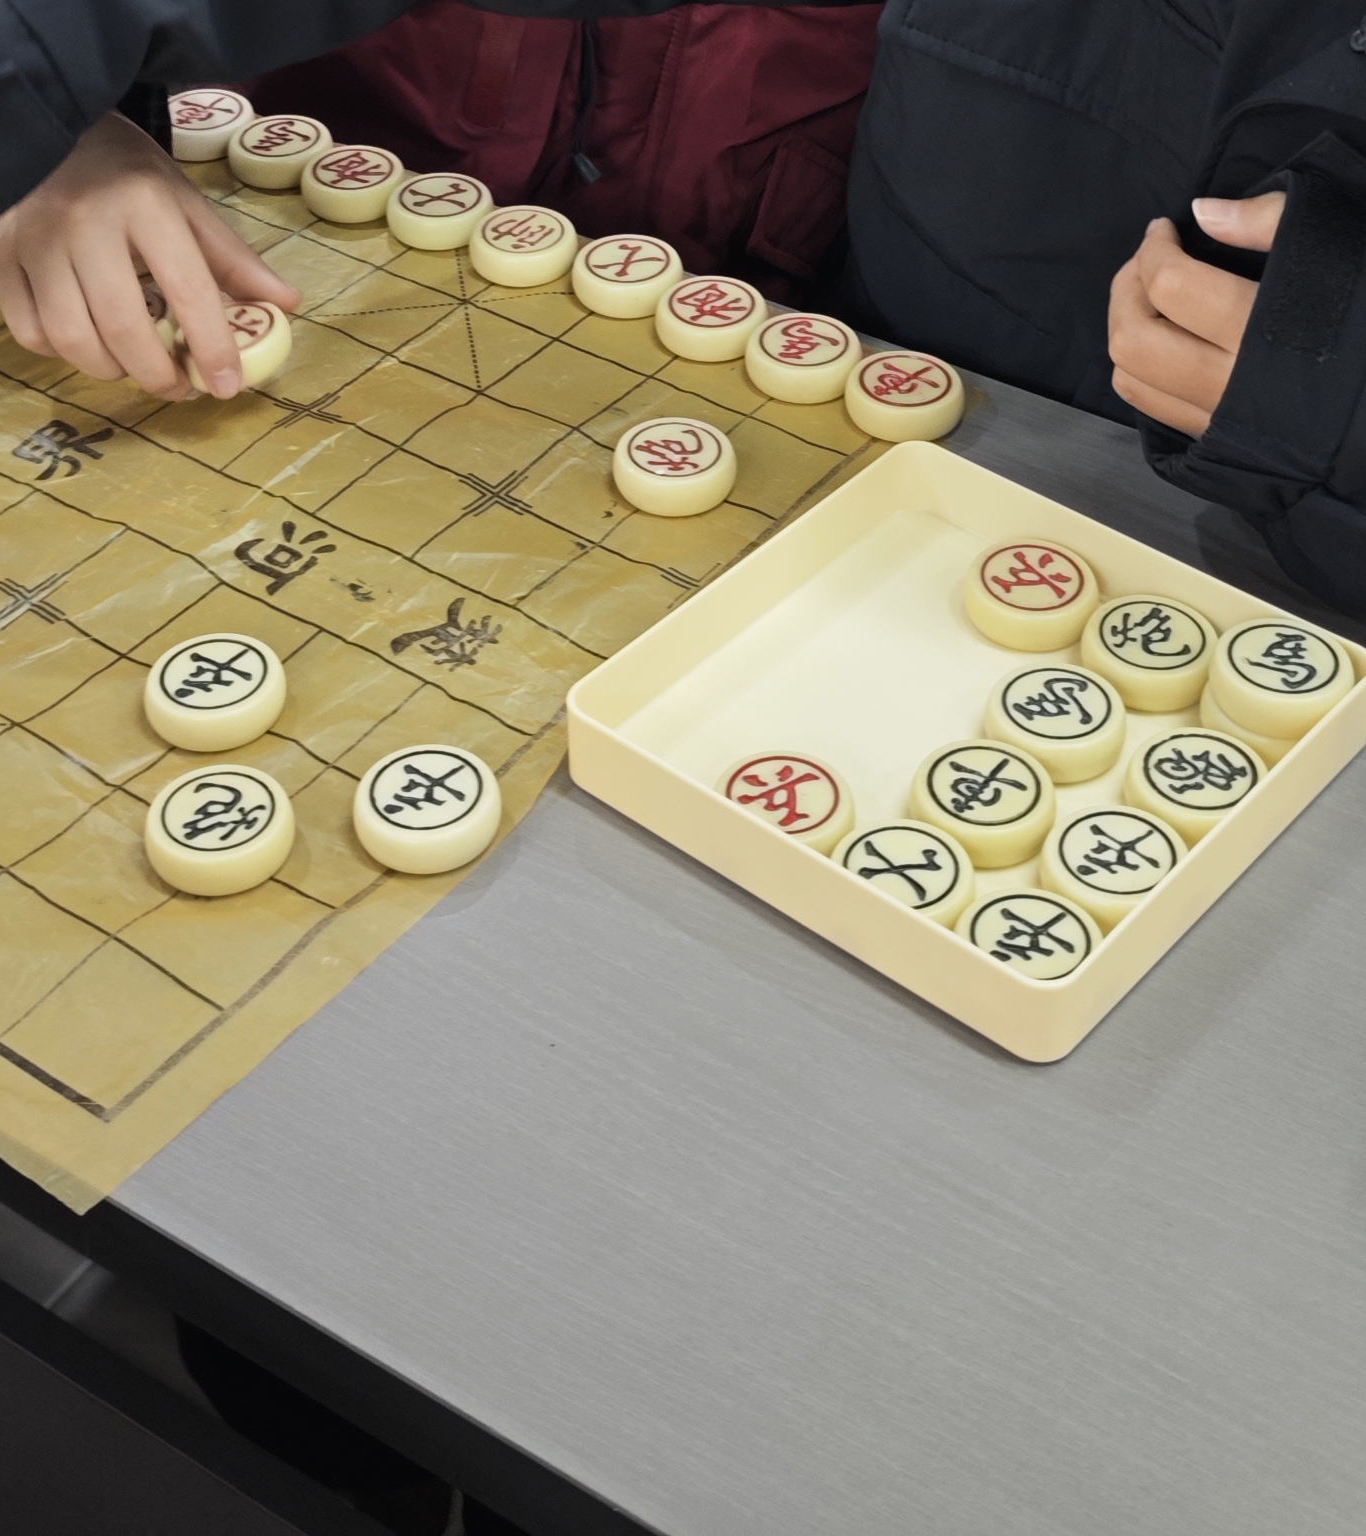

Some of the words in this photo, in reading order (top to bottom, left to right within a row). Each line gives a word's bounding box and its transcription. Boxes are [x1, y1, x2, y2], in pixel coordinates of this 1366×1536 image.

[991, 551, 1071, 598] 兵
[1110, 607, 1192, 657] 炮
[174, 648, 252, 699] 卒
[182, 783, 266, 840] 炮
[383, 764, 466, 814] 卒
[737, 765, 820, 826] 兵
[1076, 824, 1161, 876] 卒
